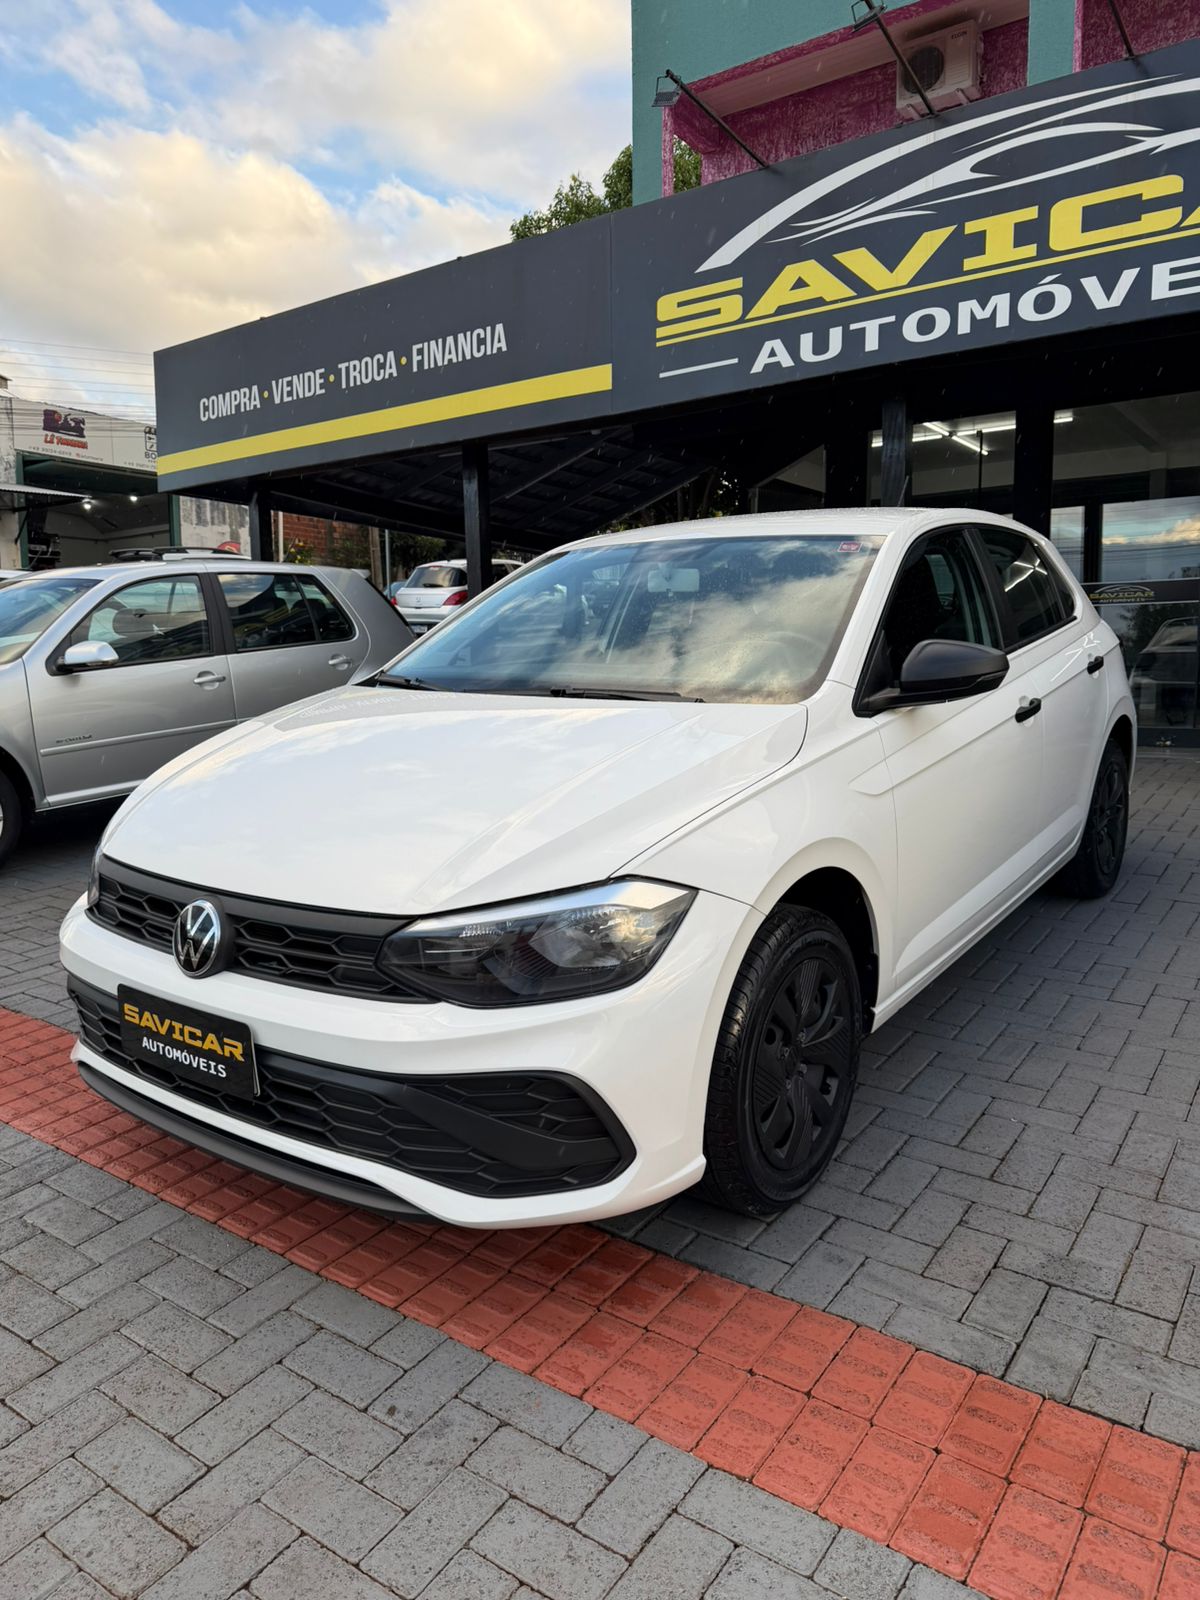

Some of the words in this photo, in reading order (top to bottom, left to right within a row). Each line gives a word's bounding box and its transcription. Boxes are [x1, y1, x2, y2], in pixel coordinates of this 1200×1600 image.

[656, 174, 1200, 337] SAVIC
[199, 384, 260, 422] COMPRA
[271, 367, 326, 405] VENDE
[338, 350, 398, 389] TROCA
[411, 322, 508, 373] FINANCIA
[123, 1002, 245, 1063] SAVICAR
[142, 1036, 228, 1079] AUTOMÓVEIS
